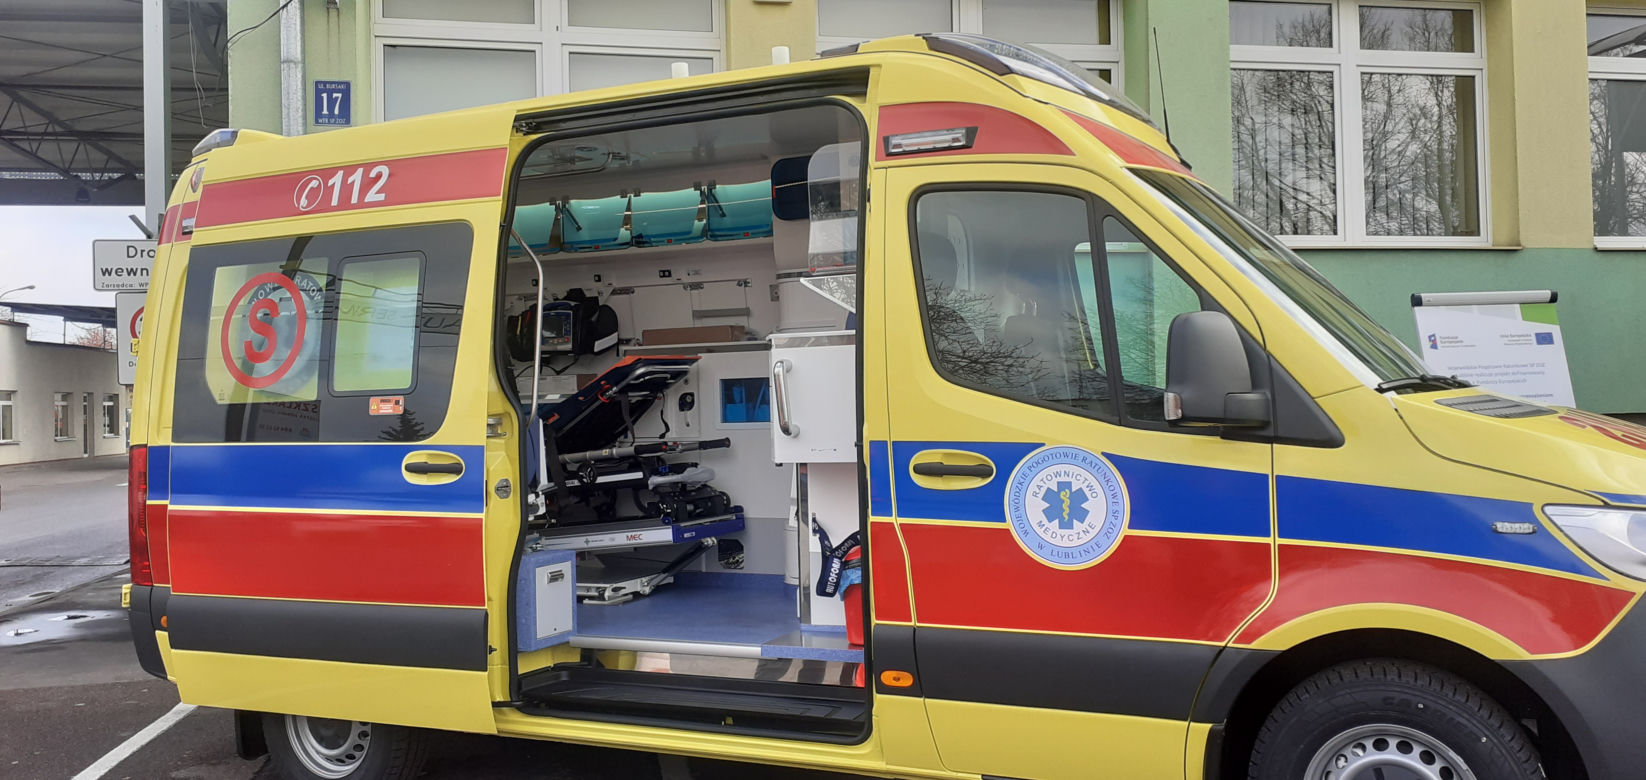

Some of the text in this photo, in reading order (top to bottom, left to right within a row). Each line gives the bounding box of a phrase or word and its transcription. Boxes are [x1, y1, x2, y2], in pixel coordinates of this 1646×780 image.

[320, 92, 343, 115] 17
[328, 165, 390, 206] 112
[100, 267, 150, 277] wewn
[243, 298, 280, 364] S
[1012, 451, 1119, 540] WOJEWÓDZKIE POGOTOWIE RATUNKOWE SP ZOZ
[1031, 470, 1099, 500] RATOWNICTWO
[626, 533, 643, 542] MEC
[1036, 521, 1097, 542] MEDYCZNE
[1037, 540, 1103, 559] W LUBLINIE
